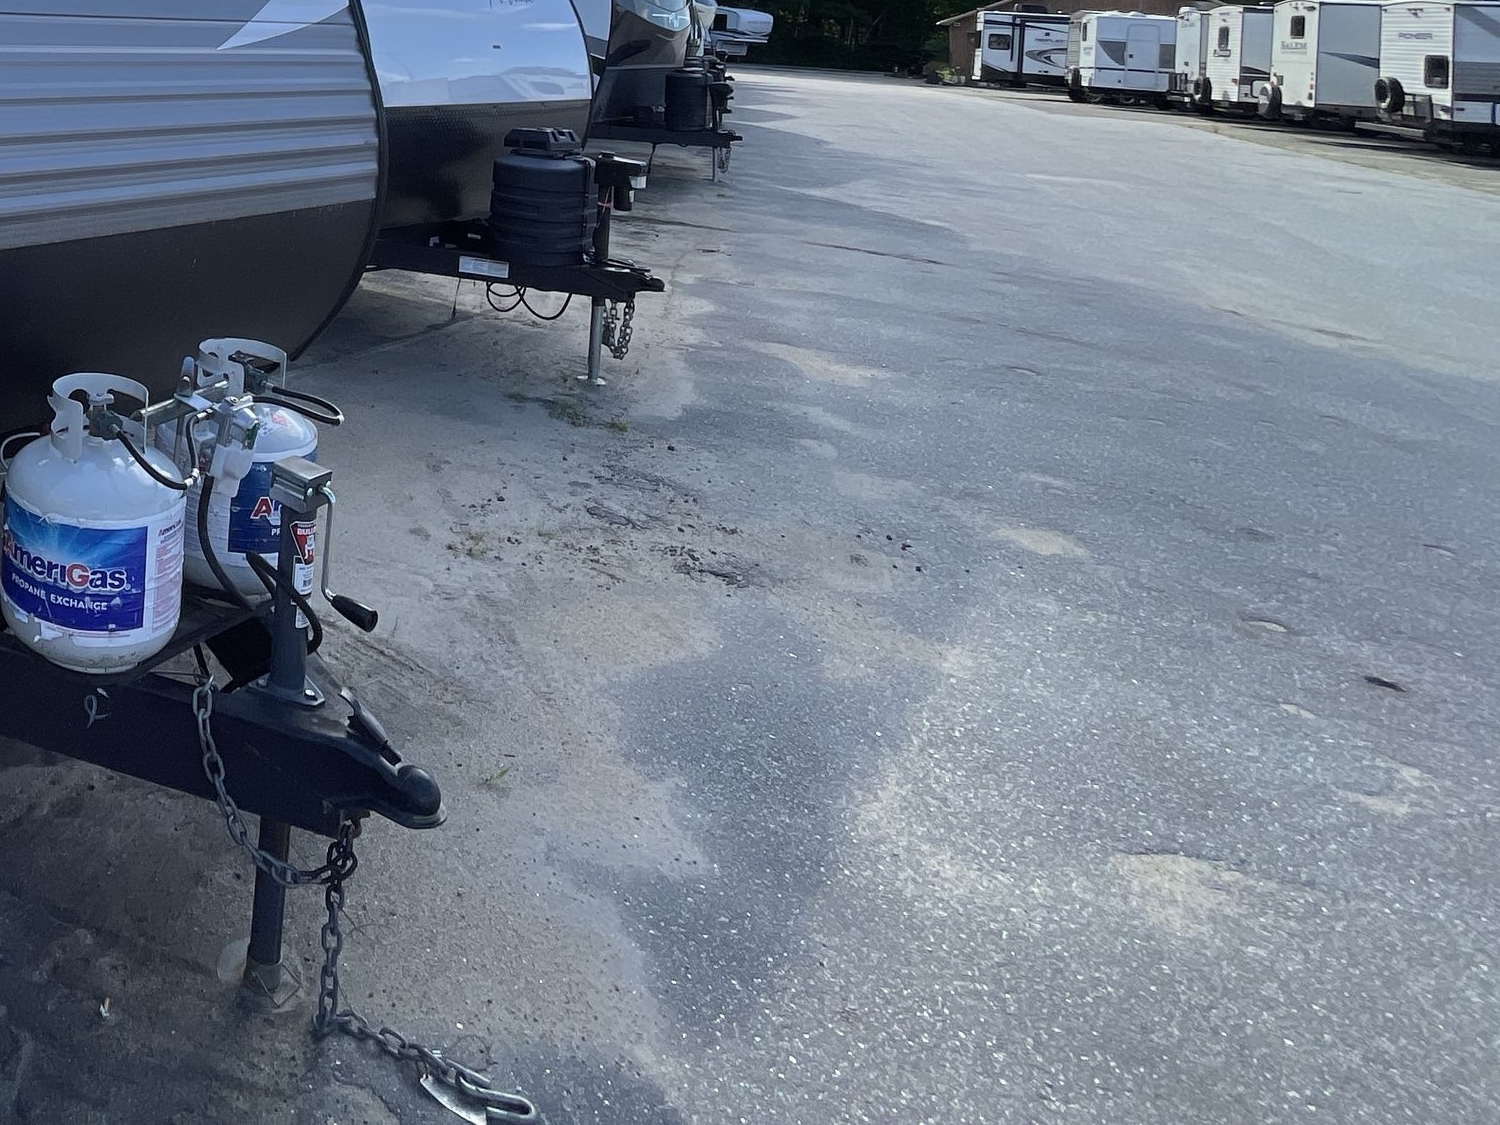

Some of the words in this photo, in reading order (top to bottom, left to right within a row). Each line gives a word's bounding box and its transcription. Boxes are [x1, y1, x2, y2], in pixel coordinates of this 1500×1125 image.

[3, 531, 127, 591] AmeriGas
[11, 572, 47, 599] PROPANE
[50, 593, 108, 611] EXCHANGE
